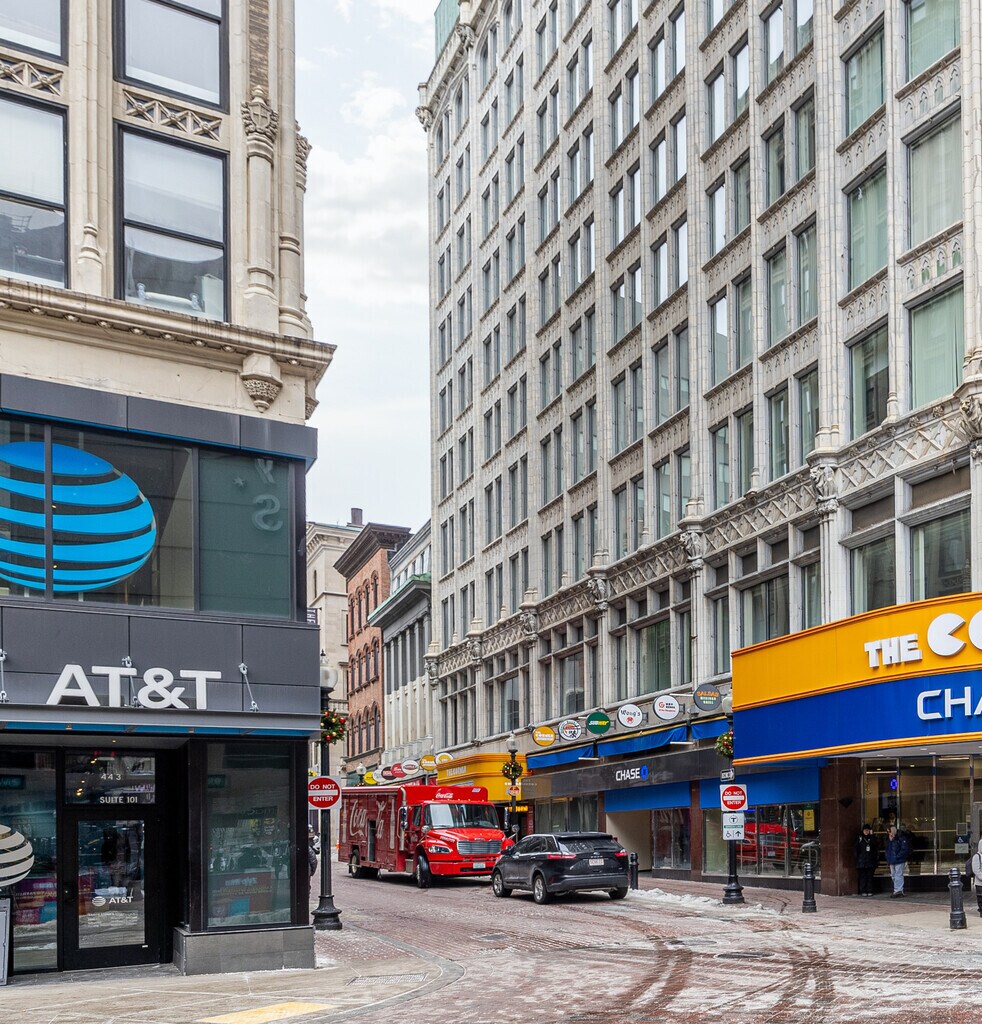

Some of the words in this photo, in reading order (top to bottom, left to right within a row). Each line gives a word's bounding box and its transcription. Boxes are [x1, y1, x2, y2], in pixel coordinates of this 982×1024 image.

[864, 633, 923, 668] THE
[46, 664, 222, 710] AT&T
[615, 768, 641, 781] CHASE
[100, 796, 124, 804] SUITE
[126, 796, 138, 804] 101
[109, 896, 133, 904] AT&T
